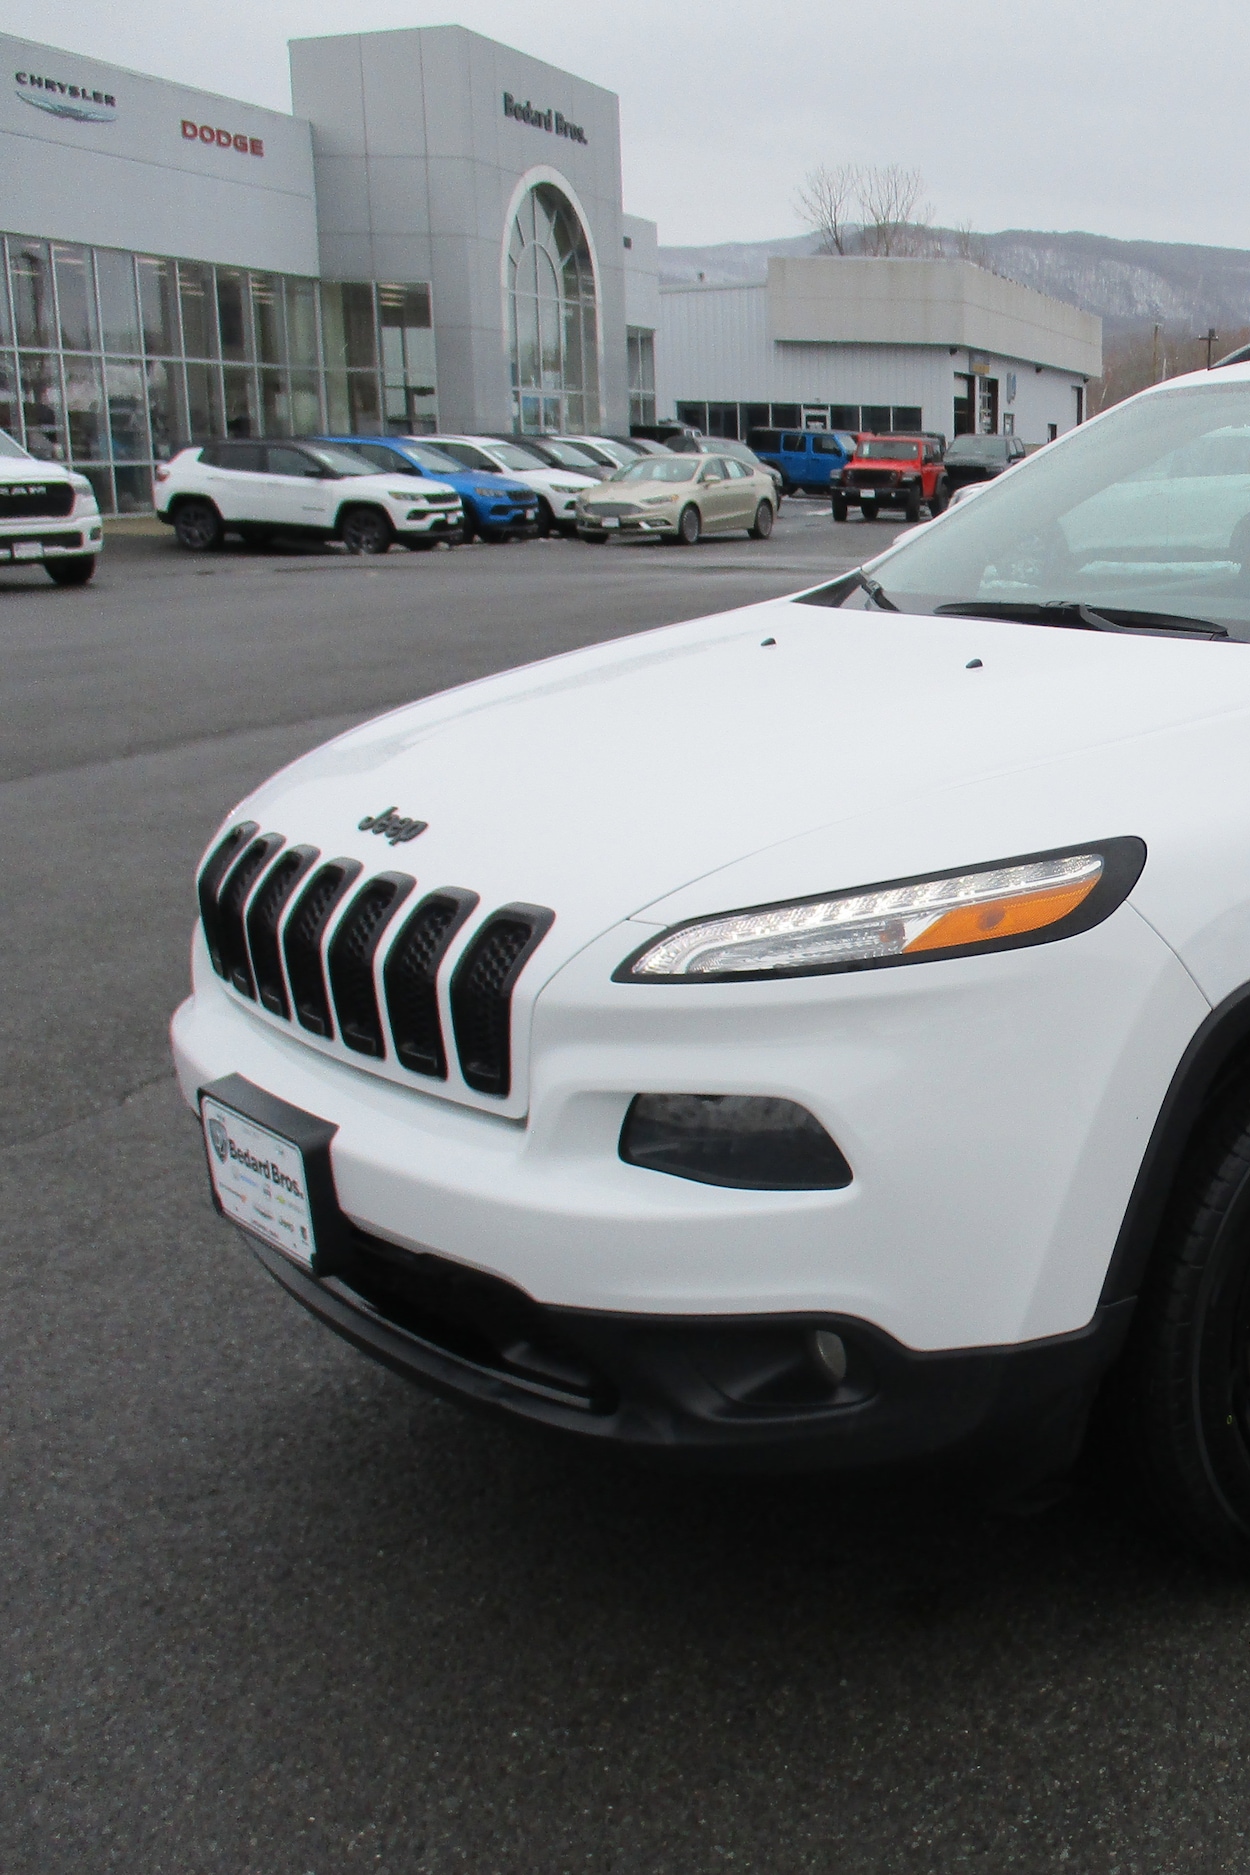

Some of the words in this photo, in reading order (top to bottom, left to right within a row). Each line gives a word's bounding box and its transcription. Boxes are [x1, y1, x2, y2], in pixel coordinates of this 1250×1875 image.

[15, 71, 117, 107] CHRYSLER
[503, 91, 553, 133] Bedard
[181, 119, 264, 157] DODGE
[228, 1138, 270, 1180] Bedard
[271, 1163, 305, 1200] Bros.
